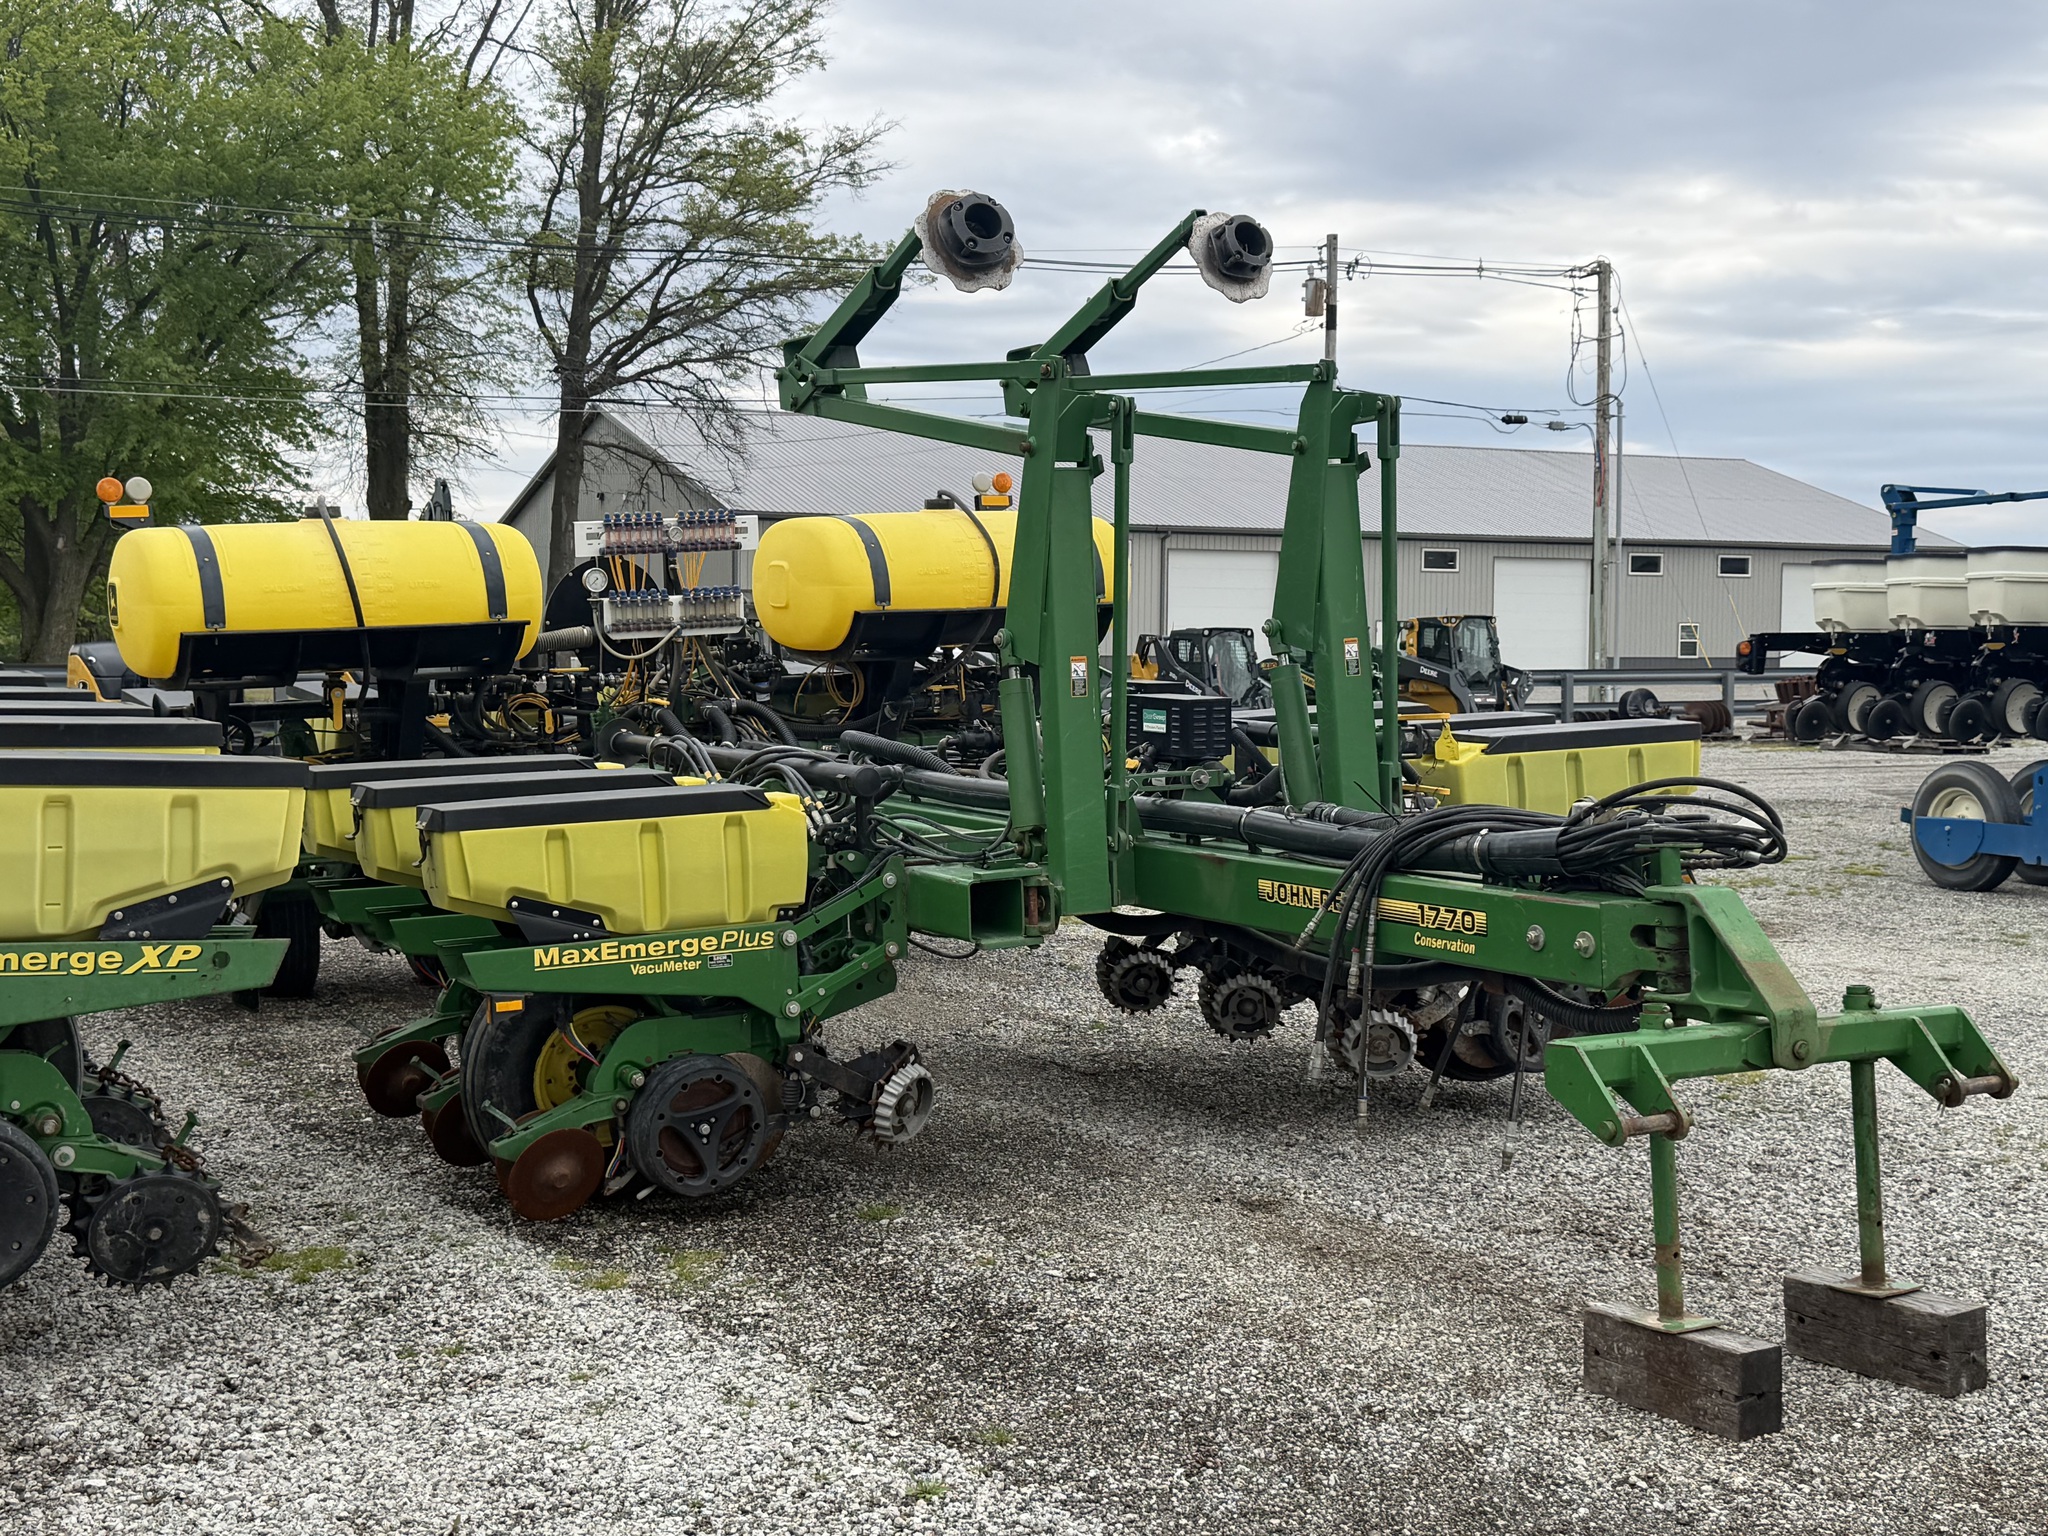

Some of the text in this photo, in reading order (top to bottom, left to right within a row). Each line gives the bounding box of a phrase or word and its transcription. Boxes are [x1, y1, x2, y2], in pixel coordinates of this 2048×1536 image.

[1420, 666, 1439, 678] DEERE
[1266, 882, 1314, 909] JOHN
[1417, 904, 1477, 935] 1770
[1414, 931, 1476, 955] Conservation
[630, 959, 702, 976] VacuMeter
